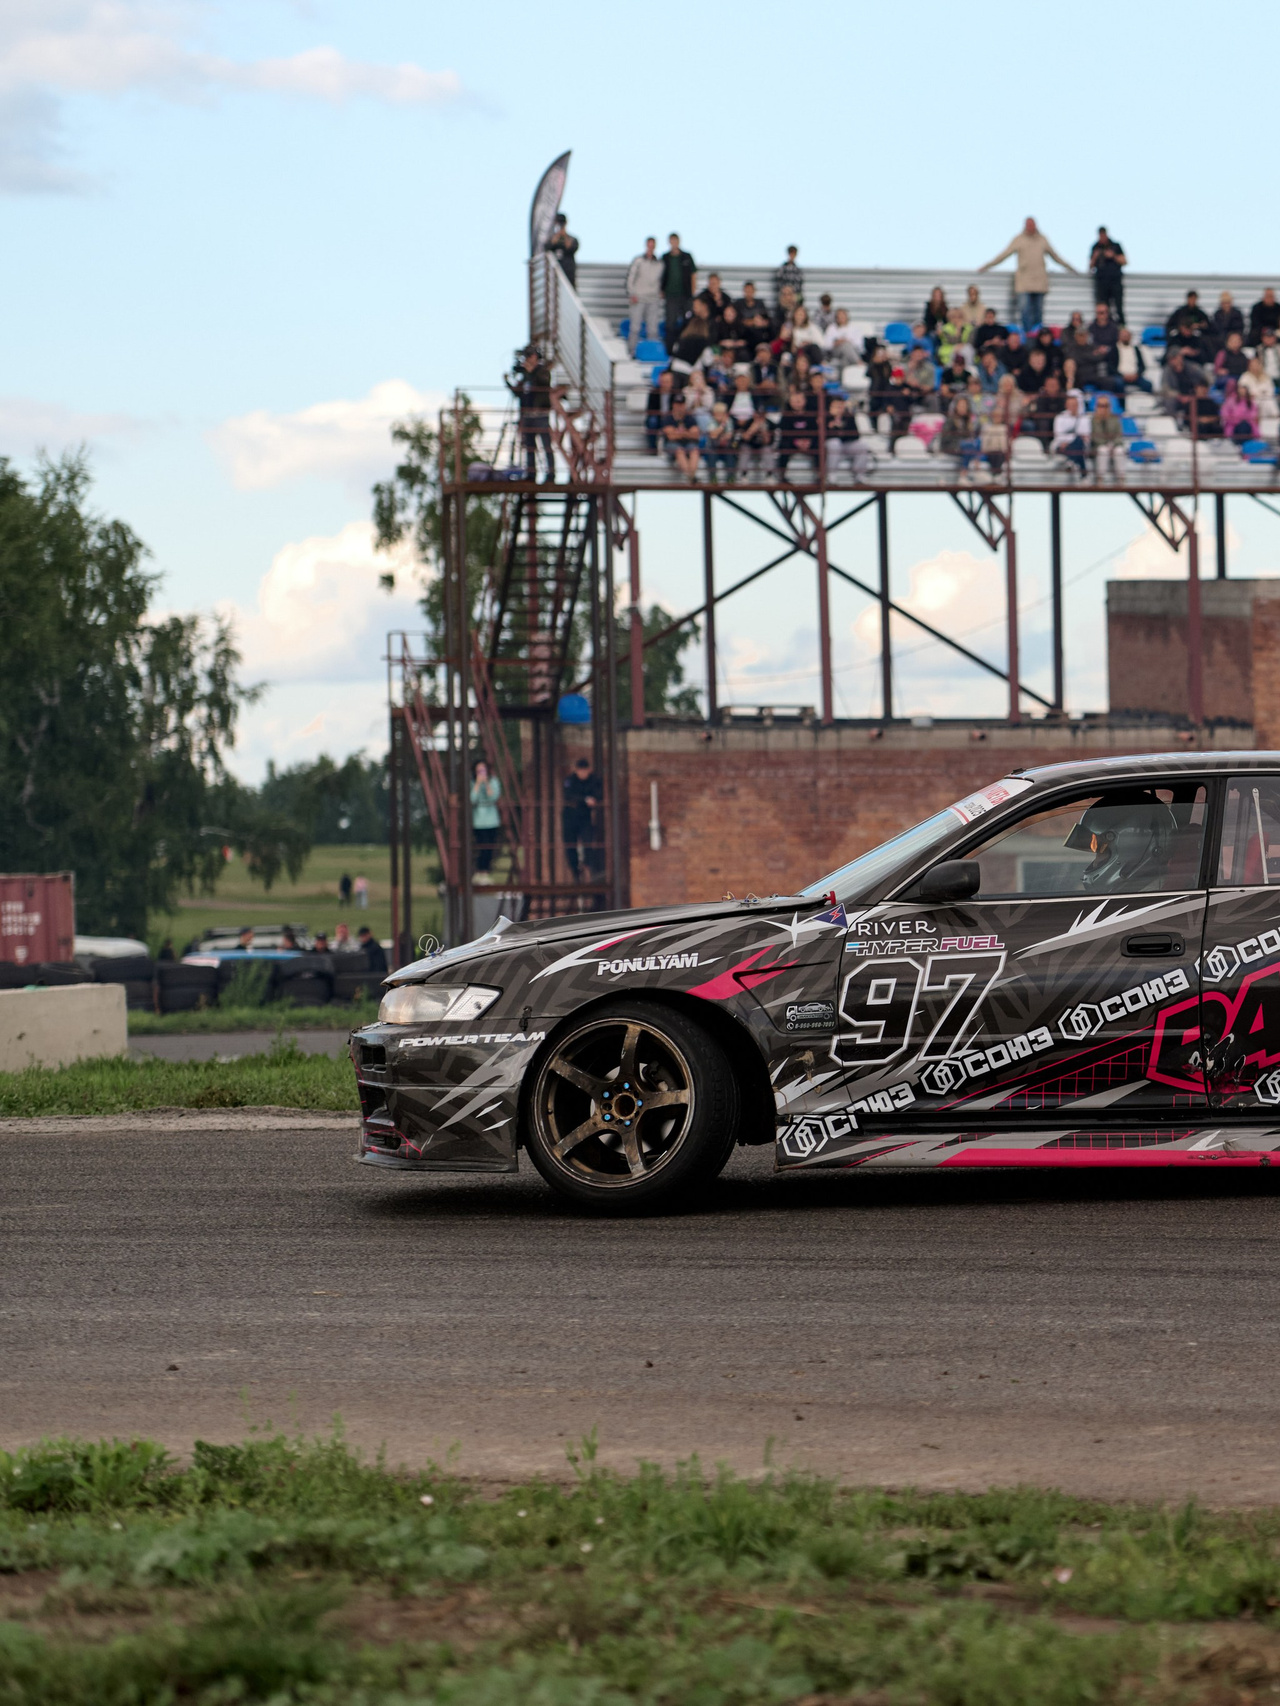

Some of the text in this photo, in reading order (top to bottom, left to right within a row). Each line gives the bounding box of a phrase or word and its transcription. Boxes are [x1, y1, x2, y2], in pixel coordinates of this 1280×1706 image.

[857, 920, 937, 936] RIVER
[597, 953, 699, 975] PONULYAM
[828, 950, 1008, 1066] 97
[1100, 968, 1190, 1022] СОЮЗ
[963, 1026, 1054, 1078] СОЮЗ
